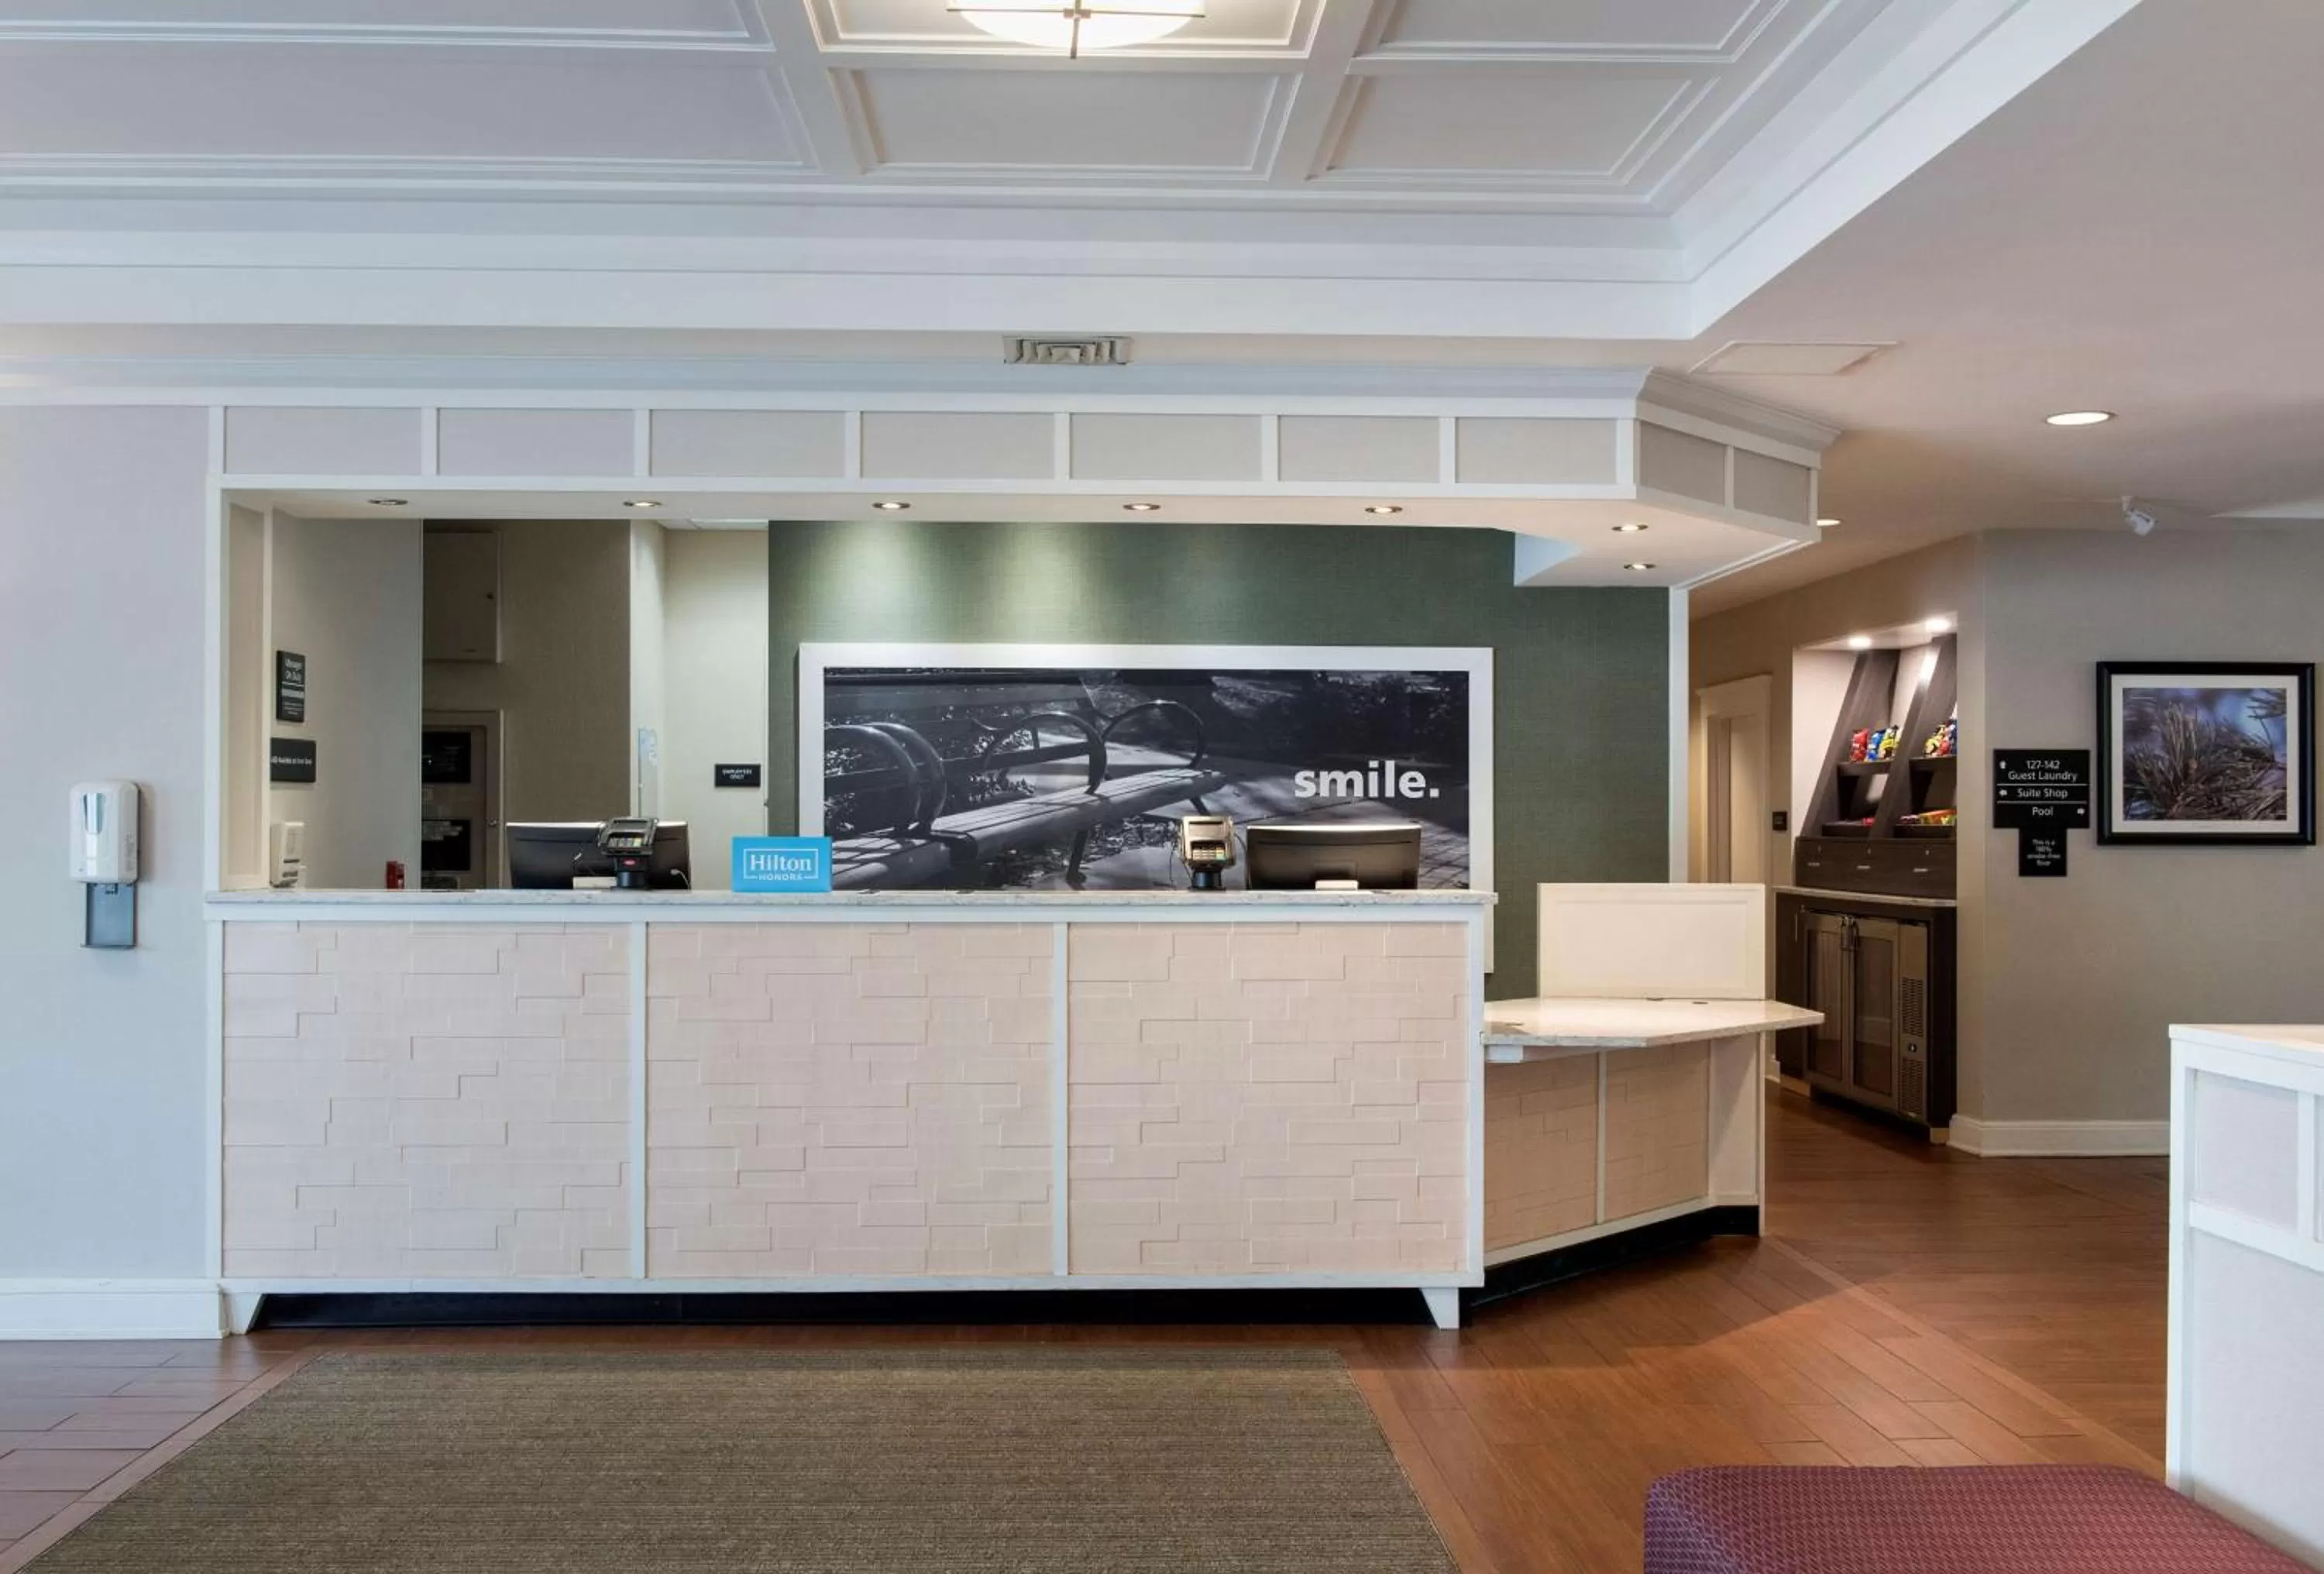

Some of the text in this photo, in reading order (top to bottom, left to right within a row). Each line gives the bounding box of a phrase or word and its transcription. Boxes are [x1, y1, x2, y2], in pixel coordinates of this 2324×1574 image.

[2026, 760, 2061, 769] 127-142
[1294, 760, 1440, 799] smile.
[2007, 771, 2078, 783] Guest Laundry
[2017, 788, 2068, 799] Suite Shop
[2032, 806, 2054, 816] Pool
[750, 854, 812, 871] Hilton
[758, 872, 804, 881] HONORS
